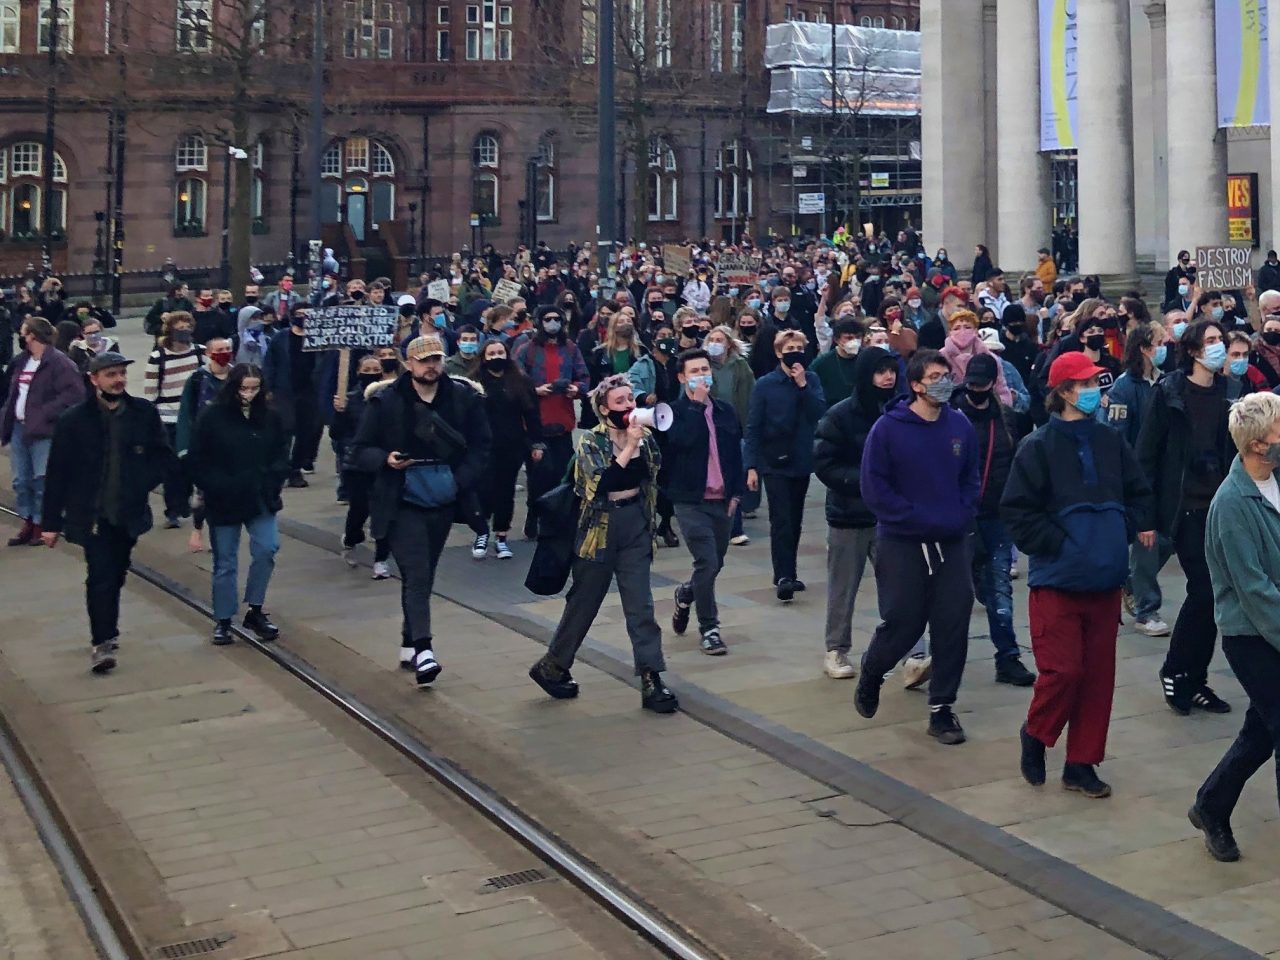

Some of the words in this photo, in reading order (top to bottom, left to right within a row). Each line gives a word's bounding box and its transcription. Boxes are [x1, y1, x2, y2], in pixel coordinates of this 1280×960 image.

[1198, 247, 1251, 268] DESTROY
[1198, 267, 1252, 288] FASCISM
[325, 308, 337, 317] OF
[338, 307, 388, 316] REPORTED
[338, 326, 364, 334] CALL
[365, 325, 389, 334] THAT
[354, 334, 394, 346] SYSTEM
